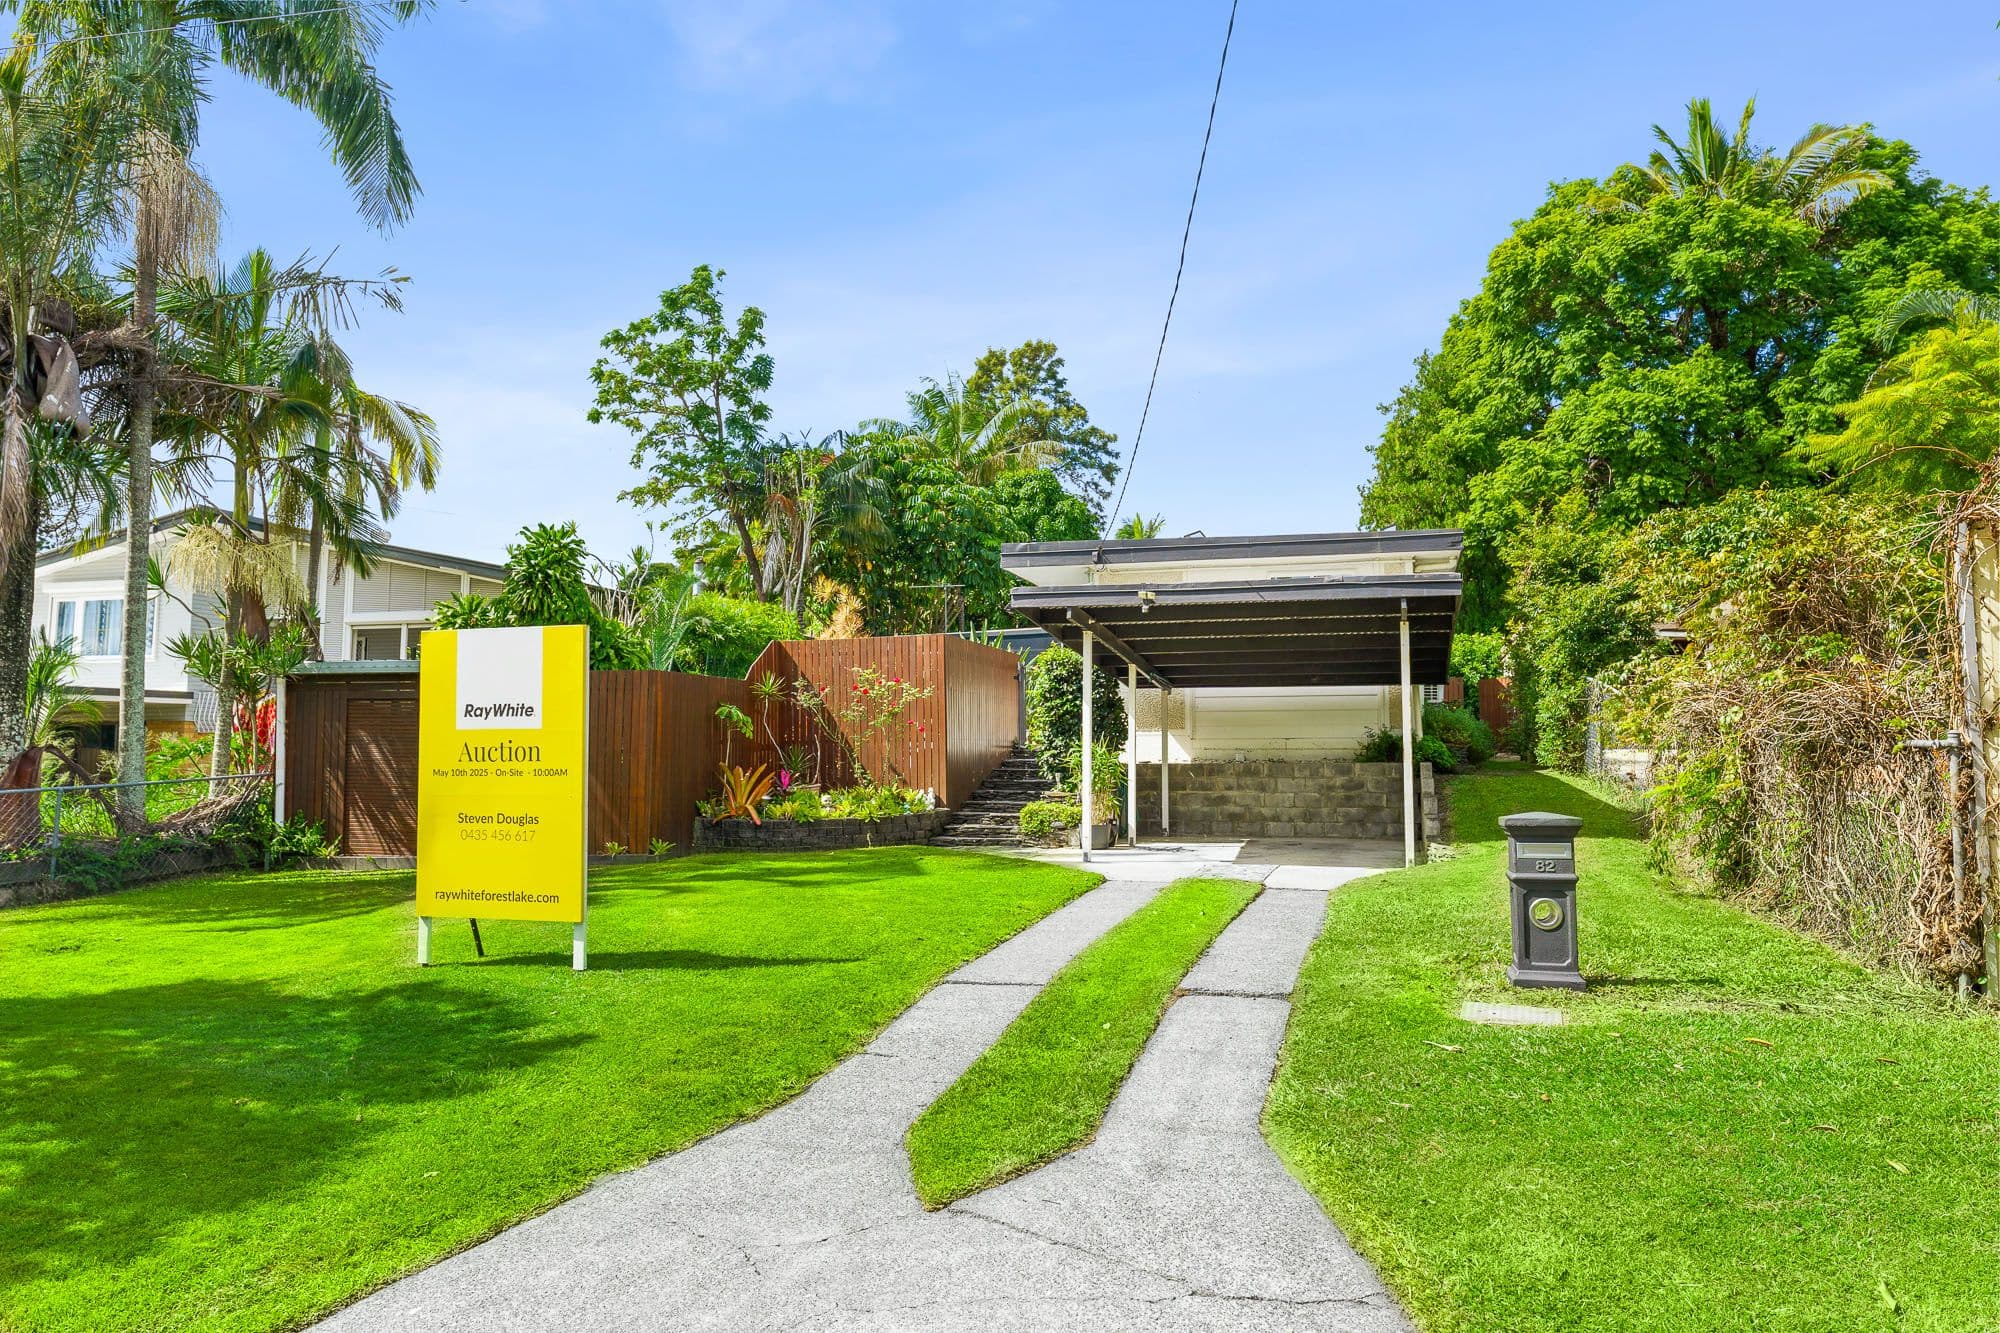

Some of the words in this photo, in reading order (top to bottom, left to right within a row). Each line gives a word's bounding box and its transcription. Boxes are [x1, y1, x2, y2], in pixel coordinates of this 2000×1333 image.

[464, 703, 534, 720] RayWhite
[458, 739, 541, 763] Auction
[432, 768, 449, 778] May
[451, 768, 468, 777] 10th
[469, 768, 489, 777] 2025
[495, 768, 524, 777] On-Site
[533, 768, 568, 777] 10:00AM
[458, 812, 494, 824] Steven
[497, 813, 540, 827] Douglas
[460, 829, 488, 841] 0435
[491, 829, 512, 842] 456
[514, 830, 536, 842] 617
[1535, 860, 1557, 872] 82
[435, 889, 560, 904] raywhiteforestlake.com
